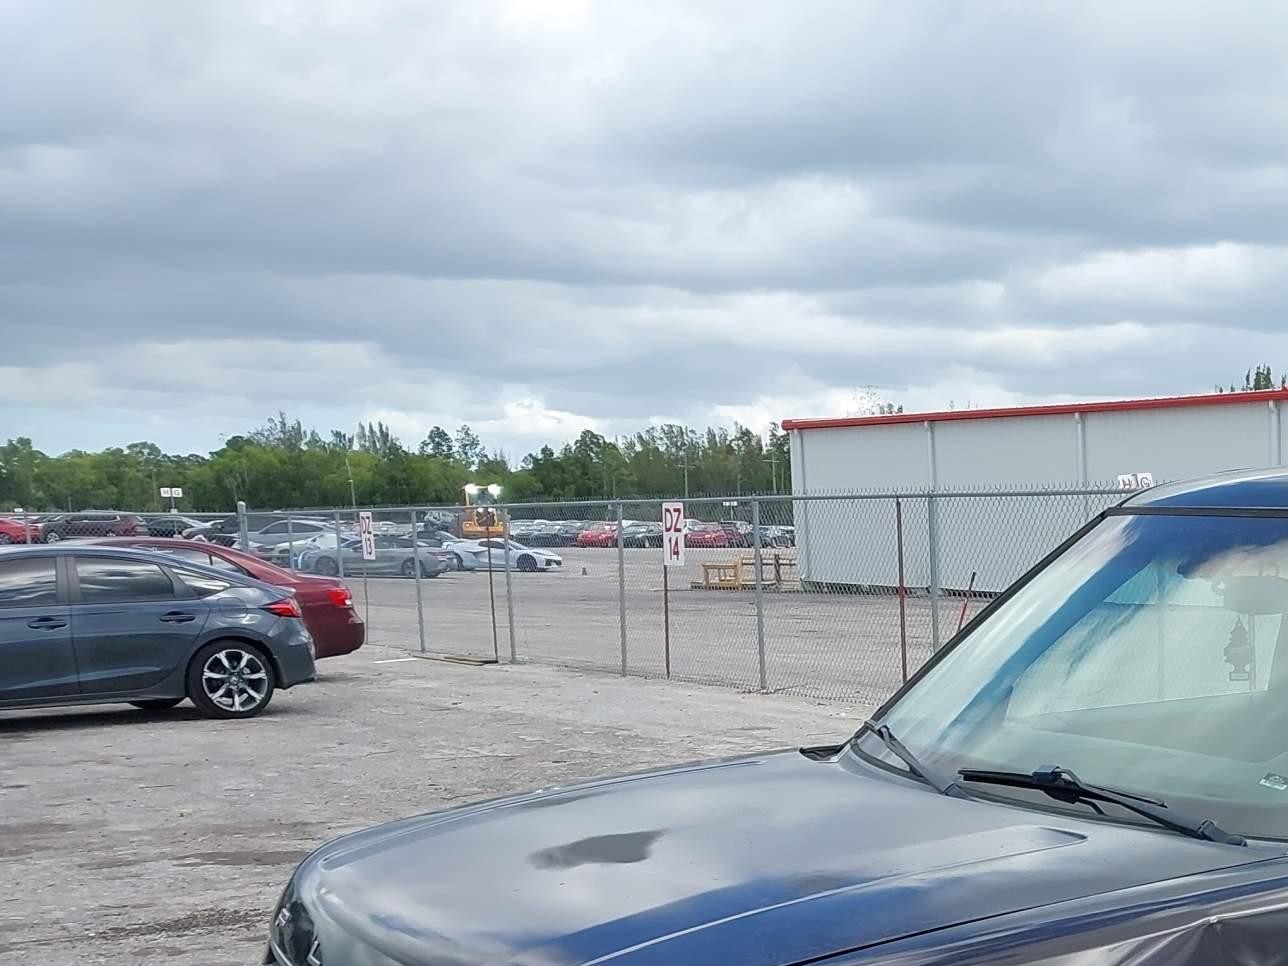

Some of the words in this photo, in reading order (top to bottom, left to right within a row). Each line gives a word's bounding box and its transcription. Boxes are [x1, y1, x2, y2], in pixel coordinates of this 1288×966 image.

[1140, 476, 1151, 489] G
[360, 515, 372, 534] DZ
[664, 507, 682, 532] DZ
[364, 537, 373, 556] 13
[668, 535, 680, 561] 14
